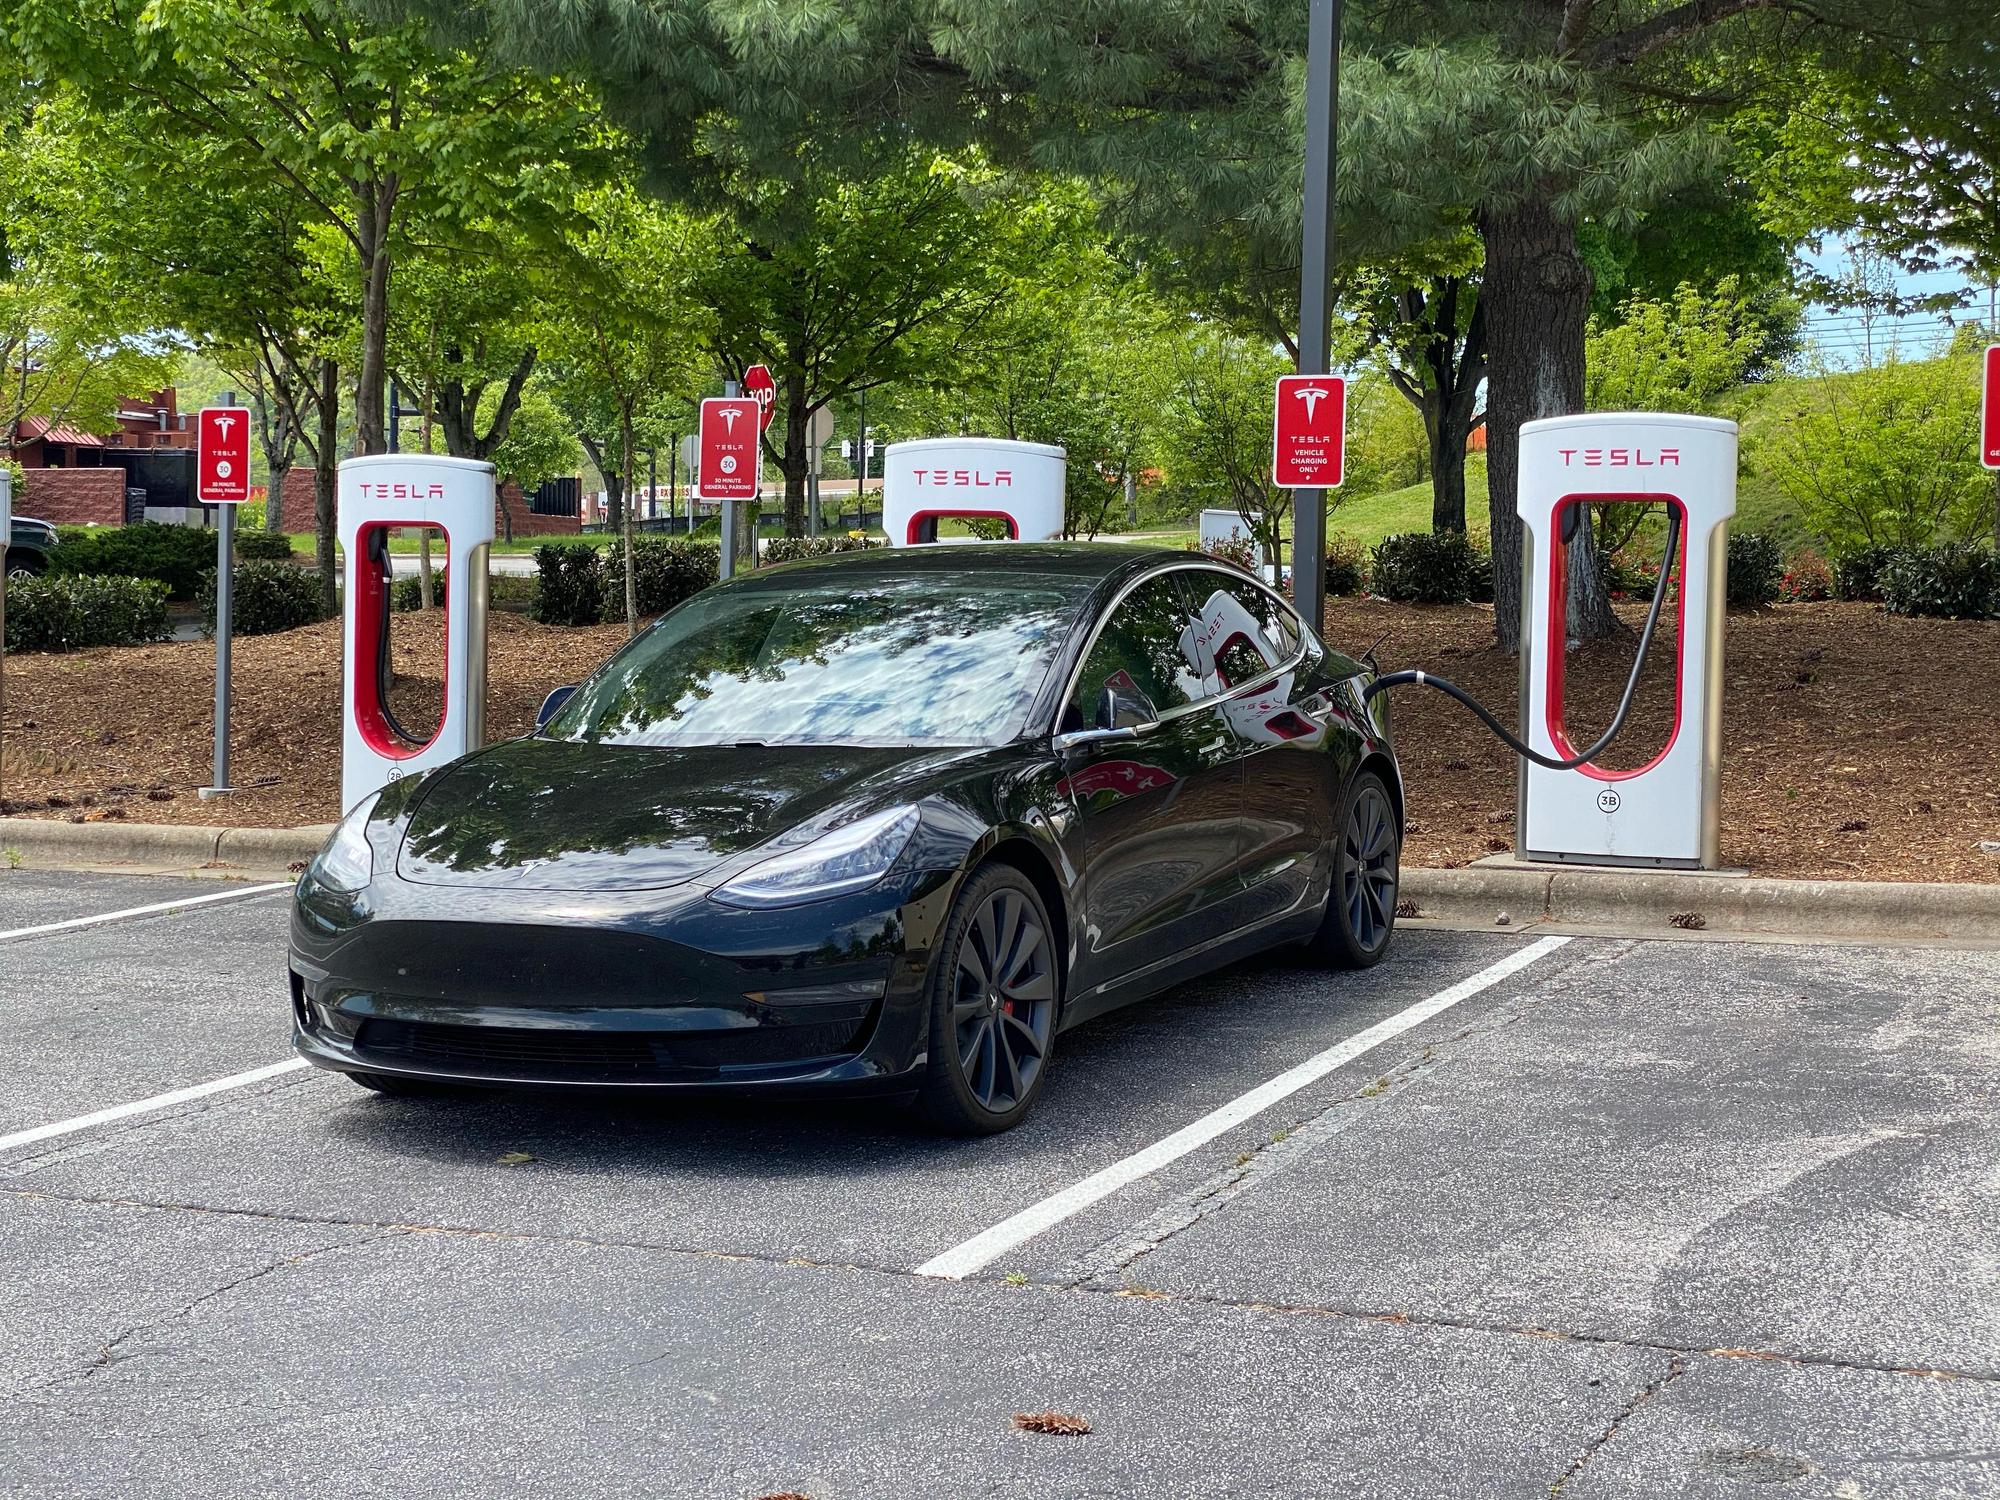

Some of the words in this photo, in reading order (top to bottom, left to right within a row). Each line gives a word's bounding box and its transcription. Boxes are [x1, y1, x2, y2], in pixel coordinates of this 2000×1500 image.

[1290, 435, 1330, 443] TESLA
[1290, 457, 1328, 465] CHARGING
[1558, 449, 1680, 466] TESLA
[219, 464, 229, 473] 30
[723, 460, 734, 469] 30
[913, 470, 1012, 487] TESLA
[360, 484, 443, 499] TESLA
[1601, 796, 1617, 806] 3B
